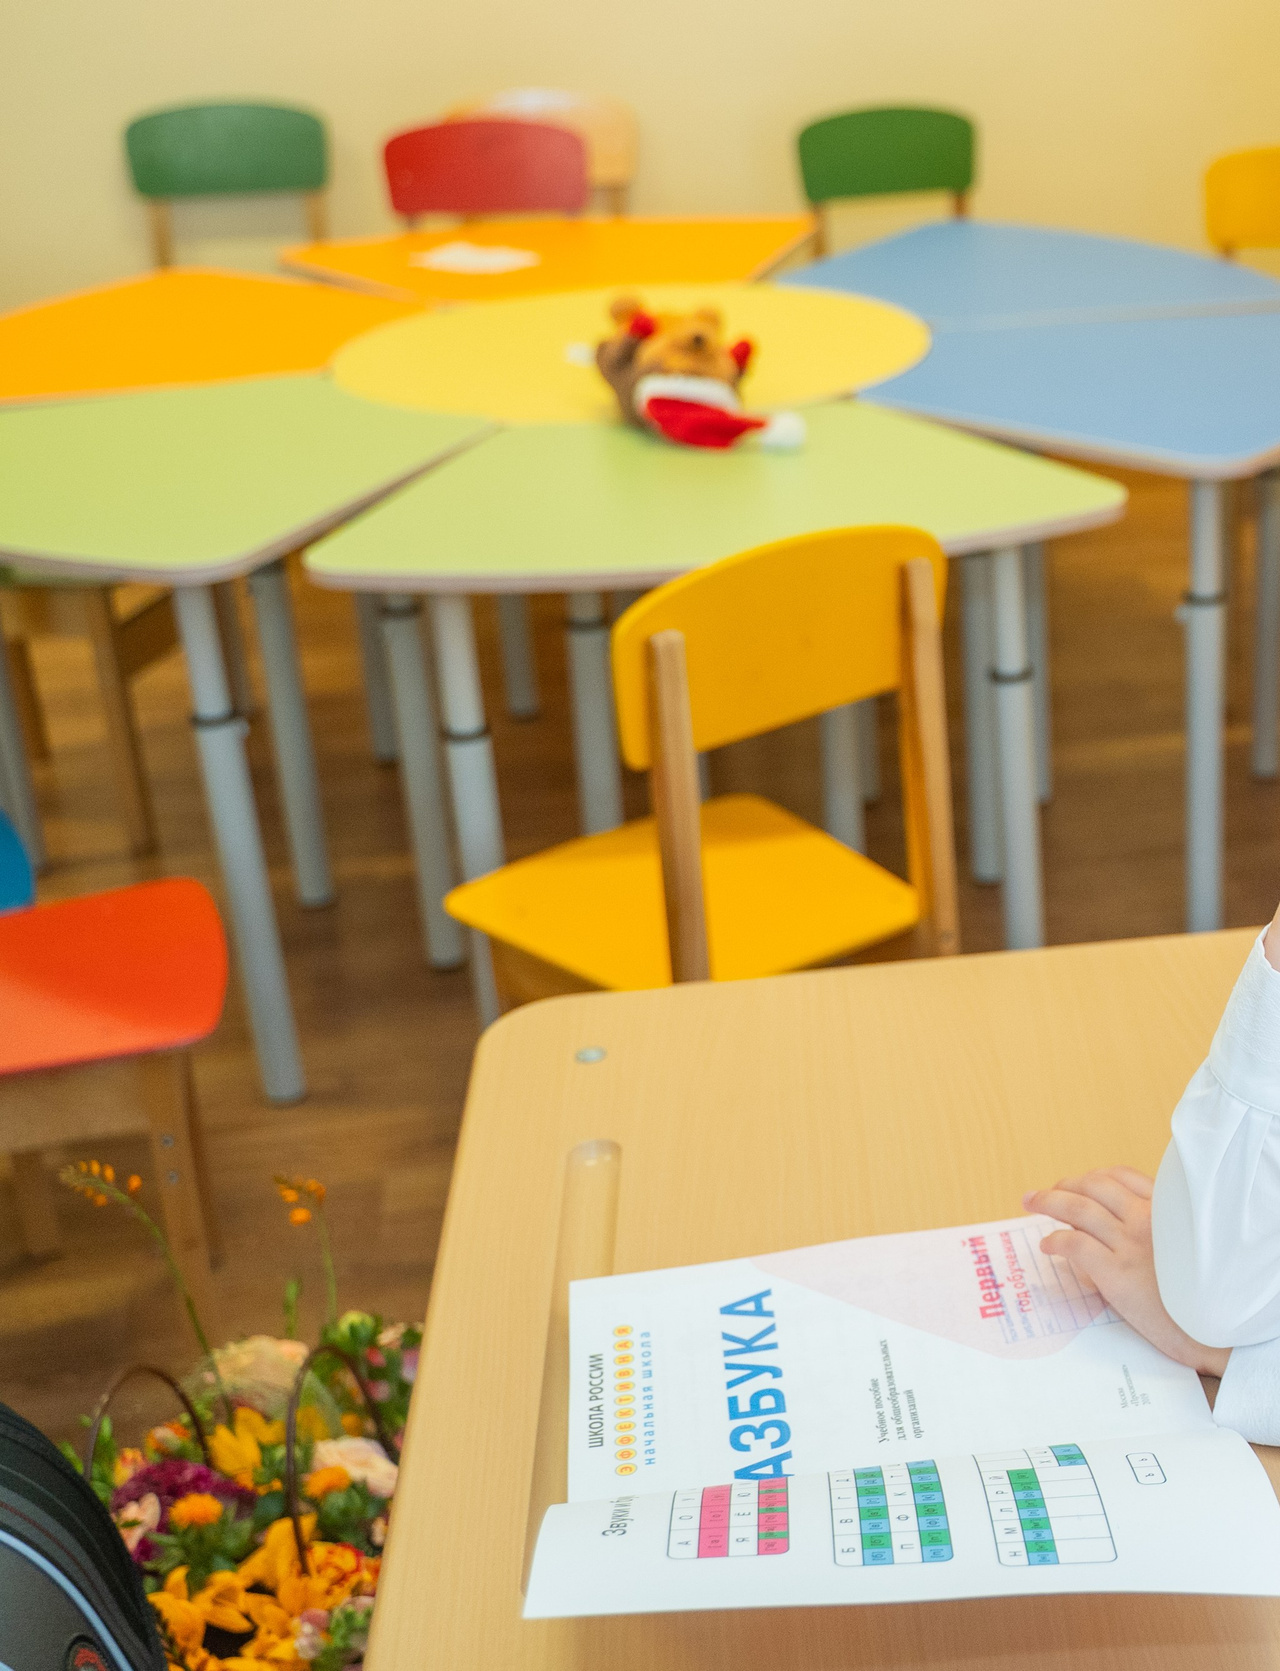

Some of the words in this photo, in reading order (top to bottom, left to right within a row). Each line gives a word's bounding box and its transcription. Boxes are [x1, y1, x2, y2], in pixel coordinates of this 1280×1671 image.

[961, 1235, 1005, 1319] Первый
[999, 1231, 1025, 1288] обучения
[1016, 1290, 1032, 1312] год
[589, 1353, 604, 1401] РОССИИ
[639, 1331, 652, 1378] школа
[613, 1325, 636, 1475] ЭФФЕКТИВНАЯ
[719, 1288, 794, 1481] АЗБУКА
[869, 1378, 883, 1409] пособие
[879, 1339, 903, 1424] общеобразовательных
[588, 1405, 604, 1448] ШКОЛА
[642, 1385, 656, 1465] начальная
[875, 1411, 890, 1443] Учебное
[897, 1427, 906, 1440] для
[903, 1389, 924, 1438] организаций
[601, 1508, 634, 1536] Звуки
